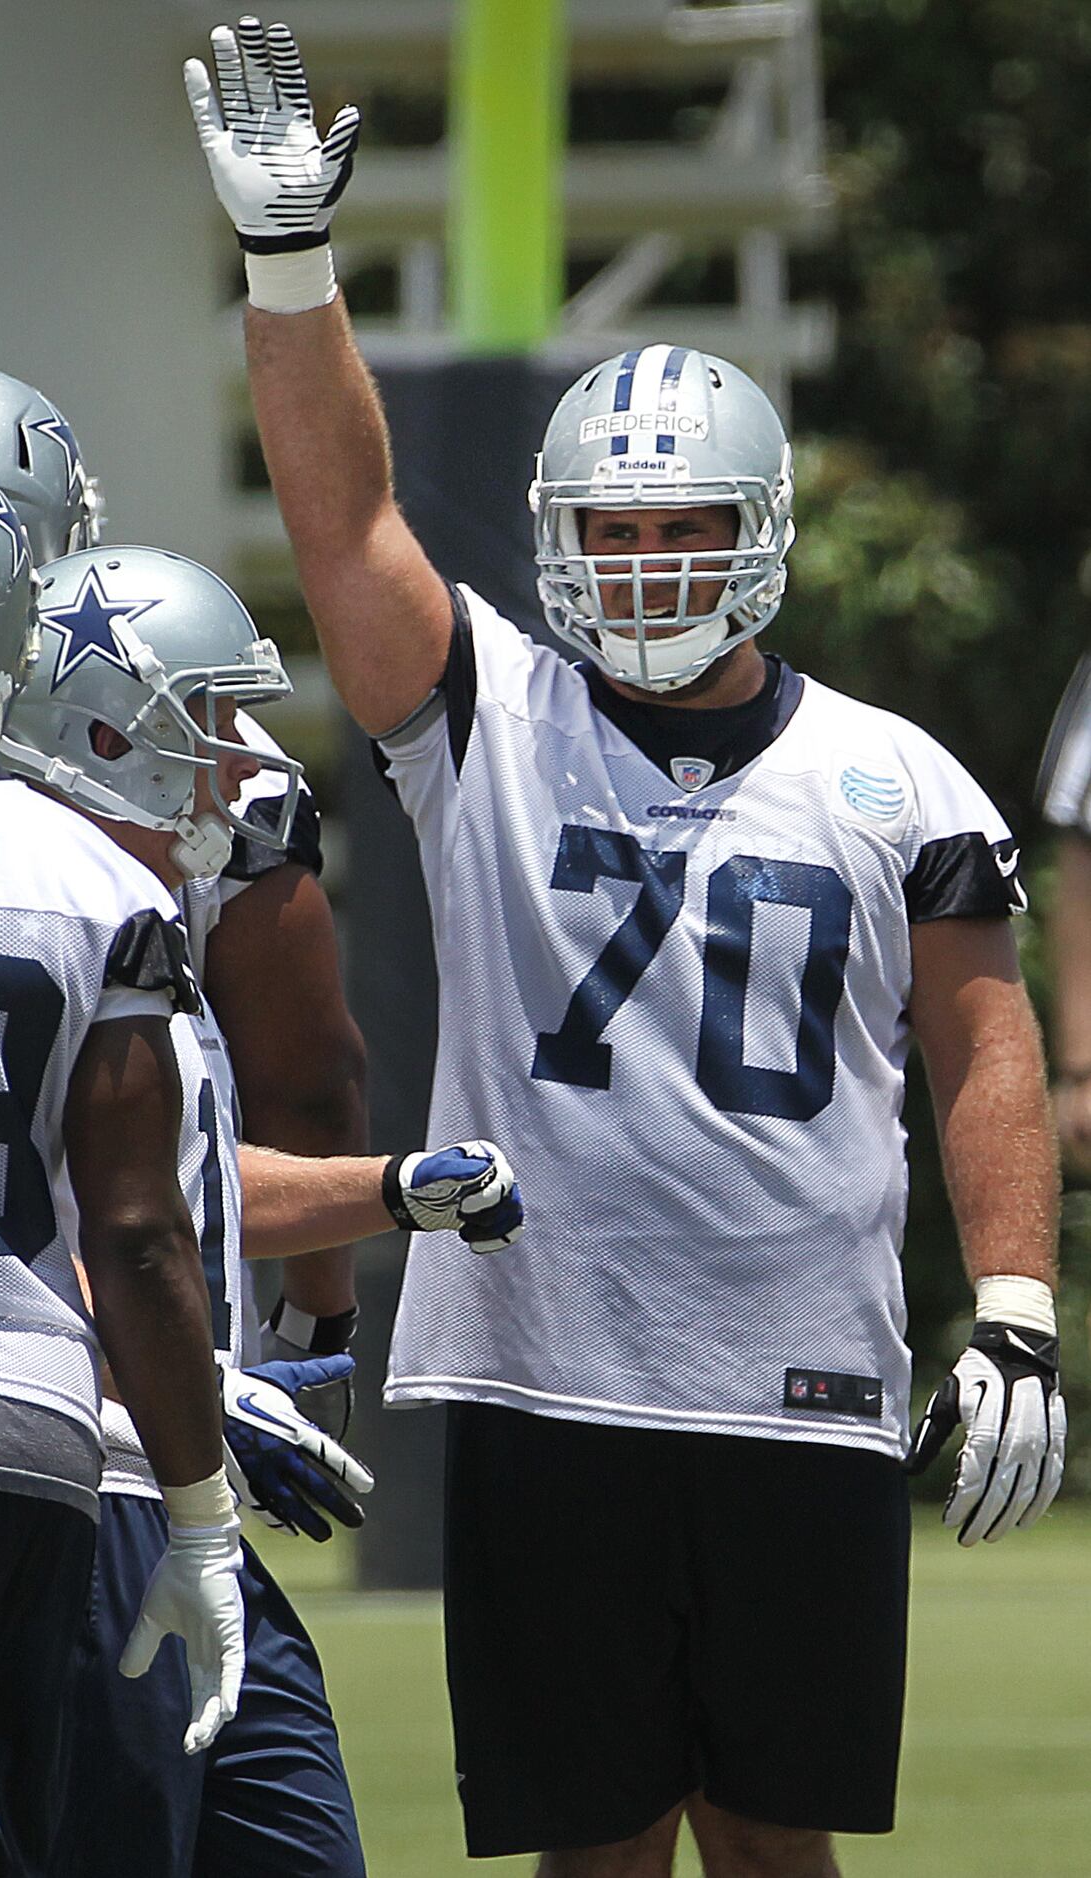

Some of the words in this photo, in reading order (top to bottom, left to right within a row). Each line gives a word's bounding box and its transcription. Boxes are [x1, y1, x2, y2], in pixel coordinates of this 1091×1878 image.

[584, 414, 706, 439] FREDERICK
[618, 460, 666, 471] Riddell
[531, 823, 853, 1122] 70
